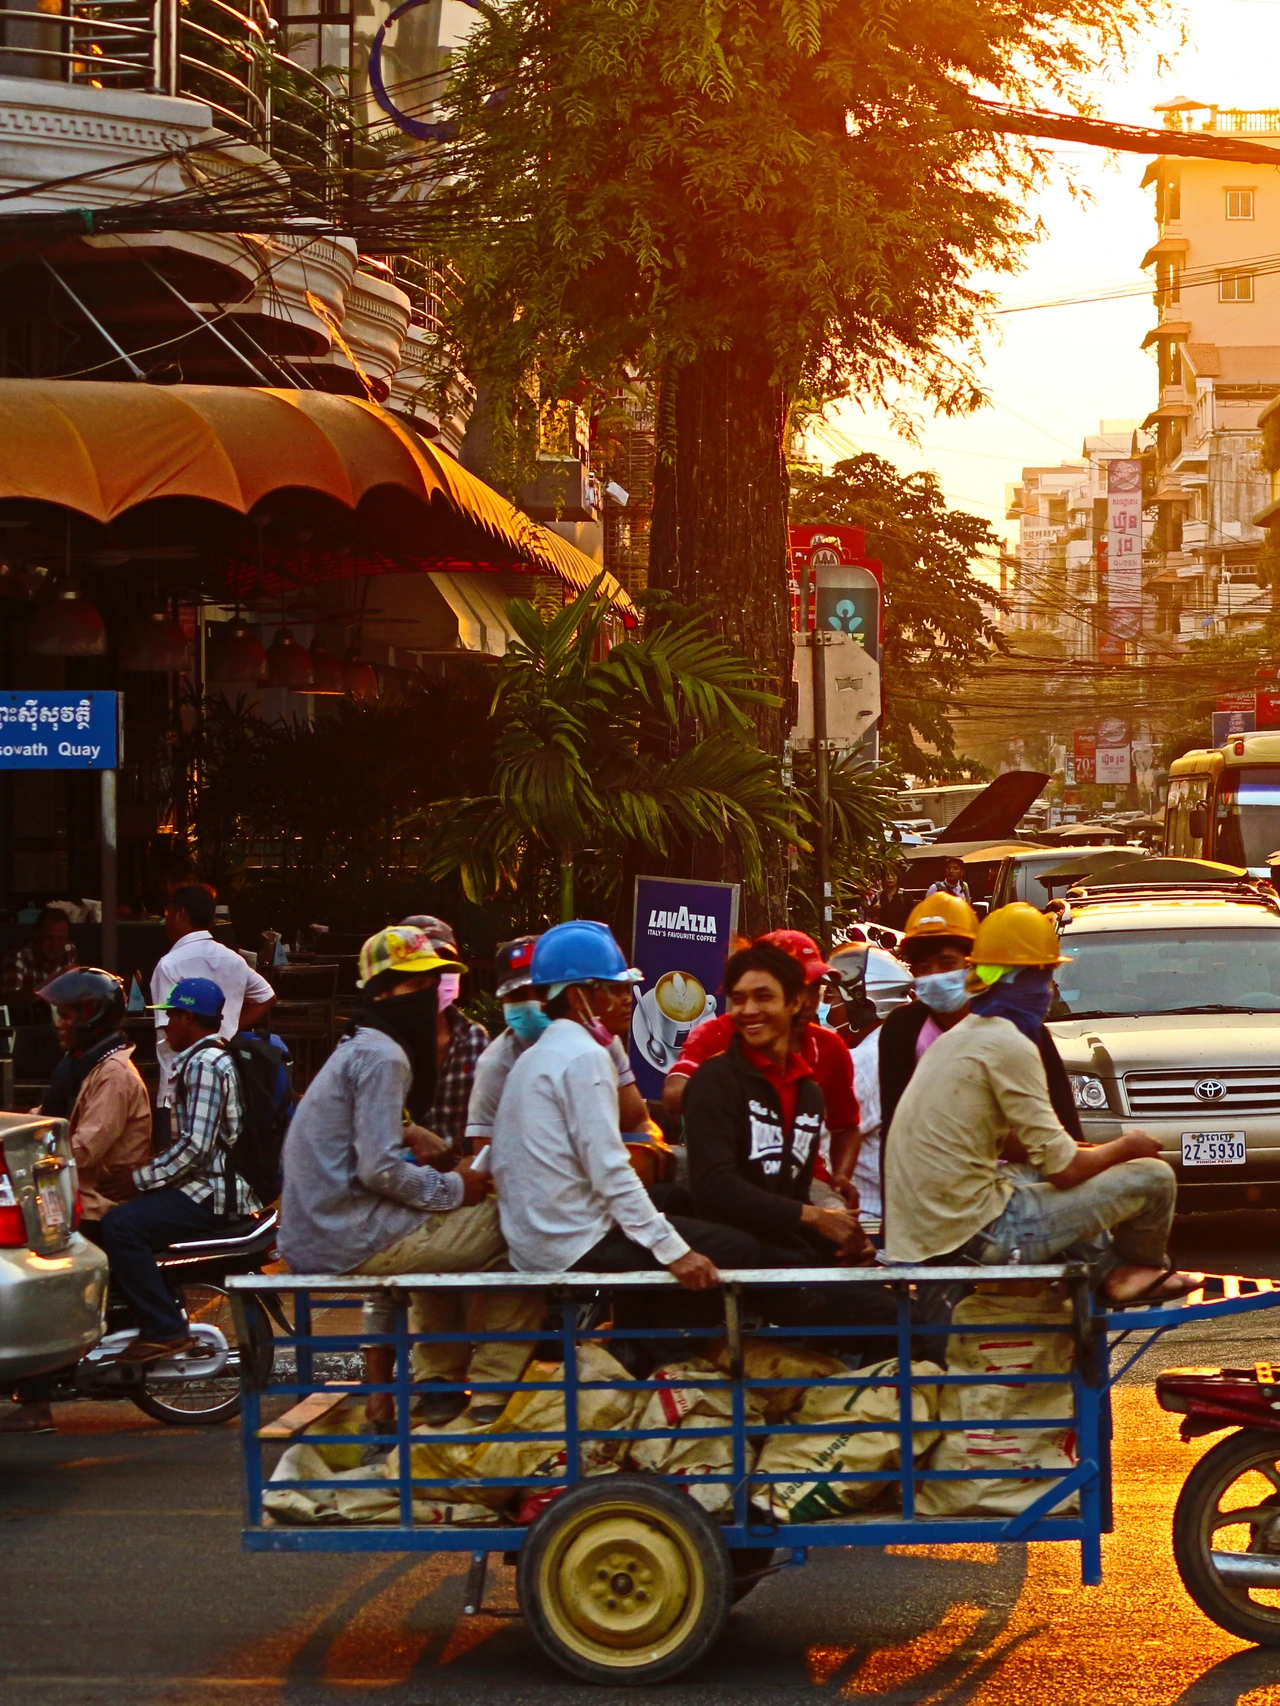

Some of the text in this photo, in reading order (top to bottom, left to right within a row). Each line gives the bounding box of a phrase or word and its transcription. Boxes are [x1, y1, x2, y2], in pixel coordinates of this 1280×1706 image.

[58, 741, 101, 760] Quay
[648, 905, 717, 934] LAVAZZA
[647, 928, 717, 943] ITALY'S FAVOURITE COFFEE
[1184, 1142, 1245, 1160] 2Z-5930
